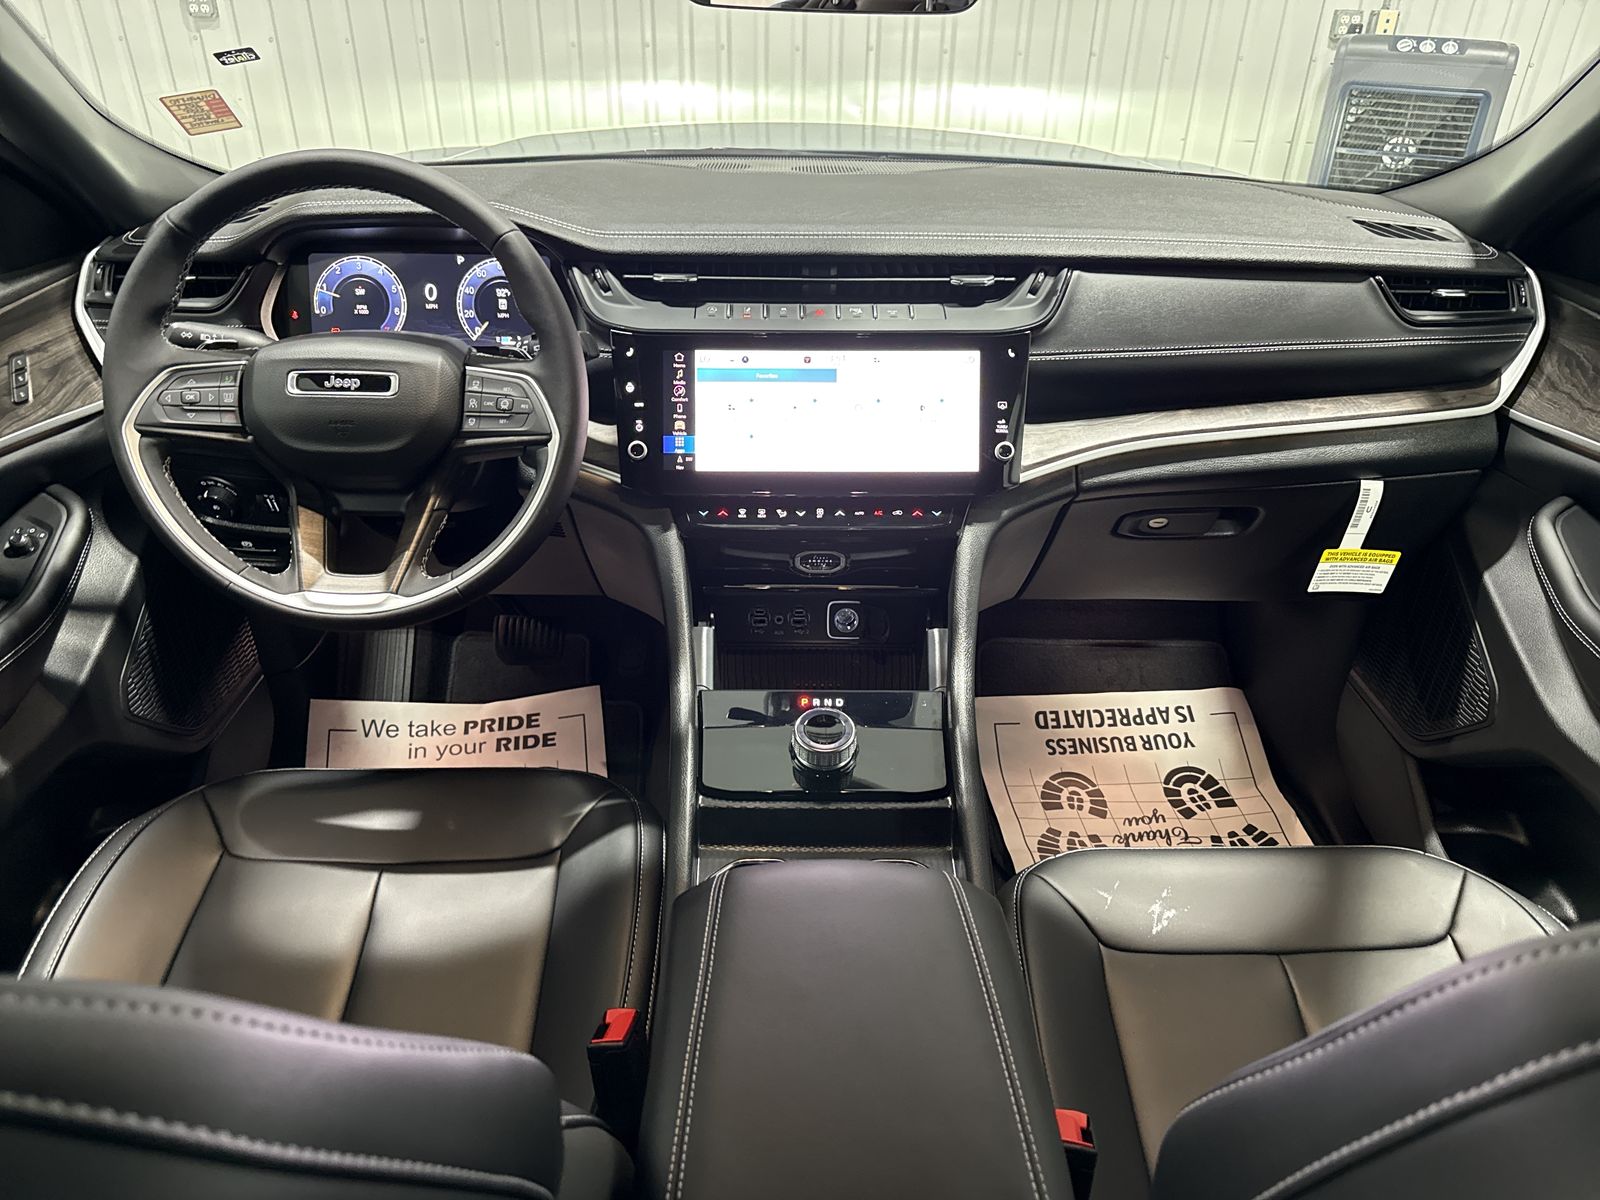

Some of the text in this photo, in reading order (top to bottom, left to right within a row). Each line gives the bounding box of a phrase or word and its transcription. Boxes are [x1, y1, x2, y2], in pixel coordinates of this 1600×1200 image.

[457, 256, 465, 265] P
[335, 266, 341, 274] 2
[378, 267, 384, 275] 4
[476, 270, 486, 278] 60
[322, 283, 327, 291] 1
[392, 284, 397, 293] 5
[464, 286, 474, 295] 40
[424, 283, 438, 302] 0
[320, 306, 326, 314] 0
[394, 306, 400, 316] 6
[464, 310, 474, 318] 20
[324, 375, 360, 390] Jeep
[801, 698, 844, 706] P R N D
[1034, 704, 1196, 730] IS APPRECIATED
[361, 712, 541, 738] We take PRIDE
[408, 732, 558, 761] in your RIDE
[1045, 732, 1196, 756] YOUR BUSINESS
[1123, 808, 1166, 826] you
[1112, 826, 1202, 847] Thank
